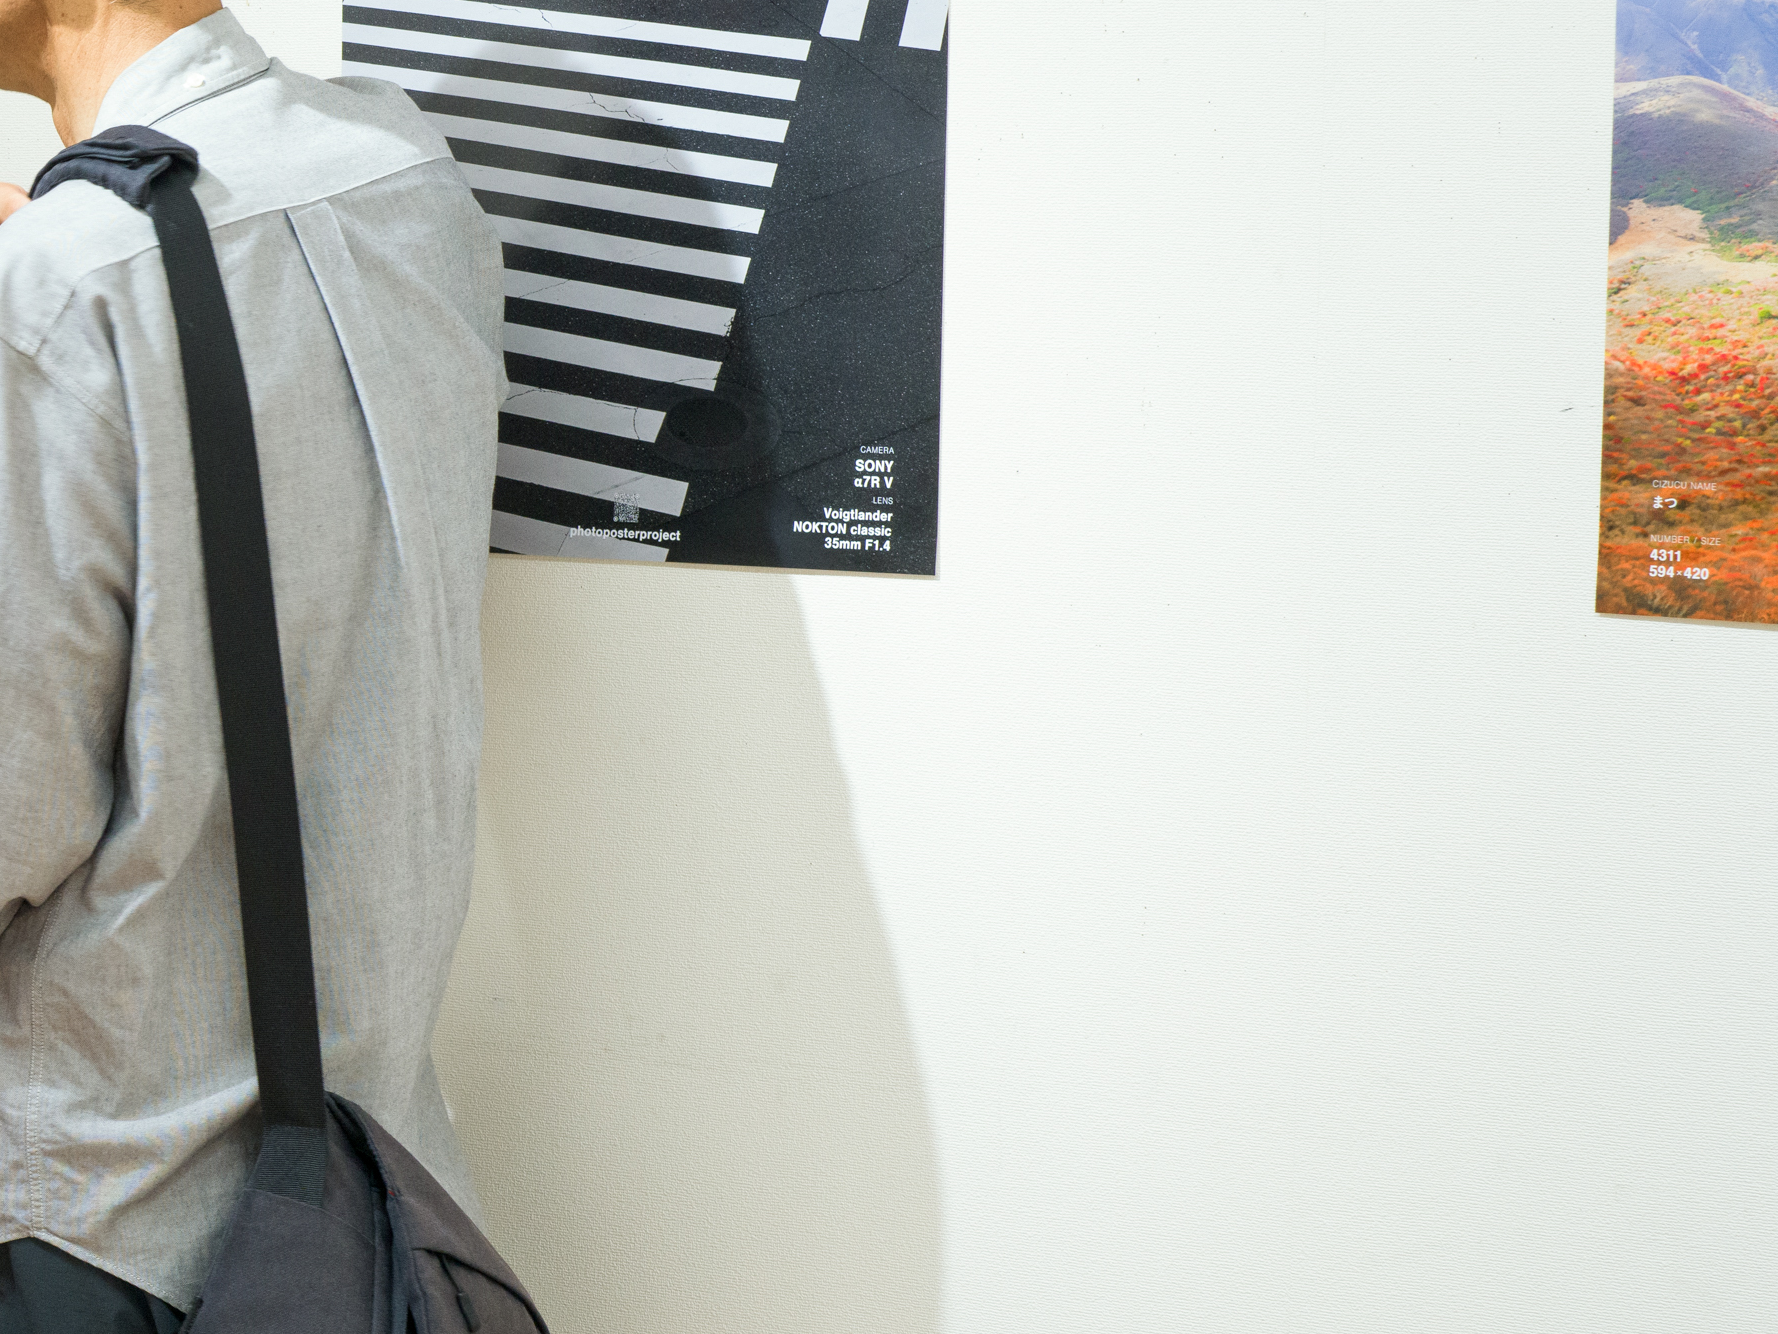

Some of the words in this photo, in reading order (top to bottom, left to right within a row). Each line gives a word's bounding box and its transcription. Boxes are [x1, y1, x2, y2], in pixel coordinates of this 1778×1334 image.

[860, 445, 895, 454] CAMERA
[854, 459, 894, 473] SONY
[883, 476, 894, 489] V
[1652, 479, 1687, 489] CIZUCU
[1690, 481, 1717, 491] NAME
[872, 496, 894, 505] LENS
[1653, 495, 1678, 509] まつ
[823, 507, 894, 522] Voigtlander
[569, 525, 681, 543] photoposterproject
[793, 520, 847, 535] NOKTON
[850, 524, 892, 537] classic
[824, 537, 862, 550] 35mm
[864, 539, 891, 552] F1.4
[1650, 534, 1690, 544] NUMBER
[1700, 536, 1721, 546] SIZE
[1649, 548, 1682, 562] 4311
